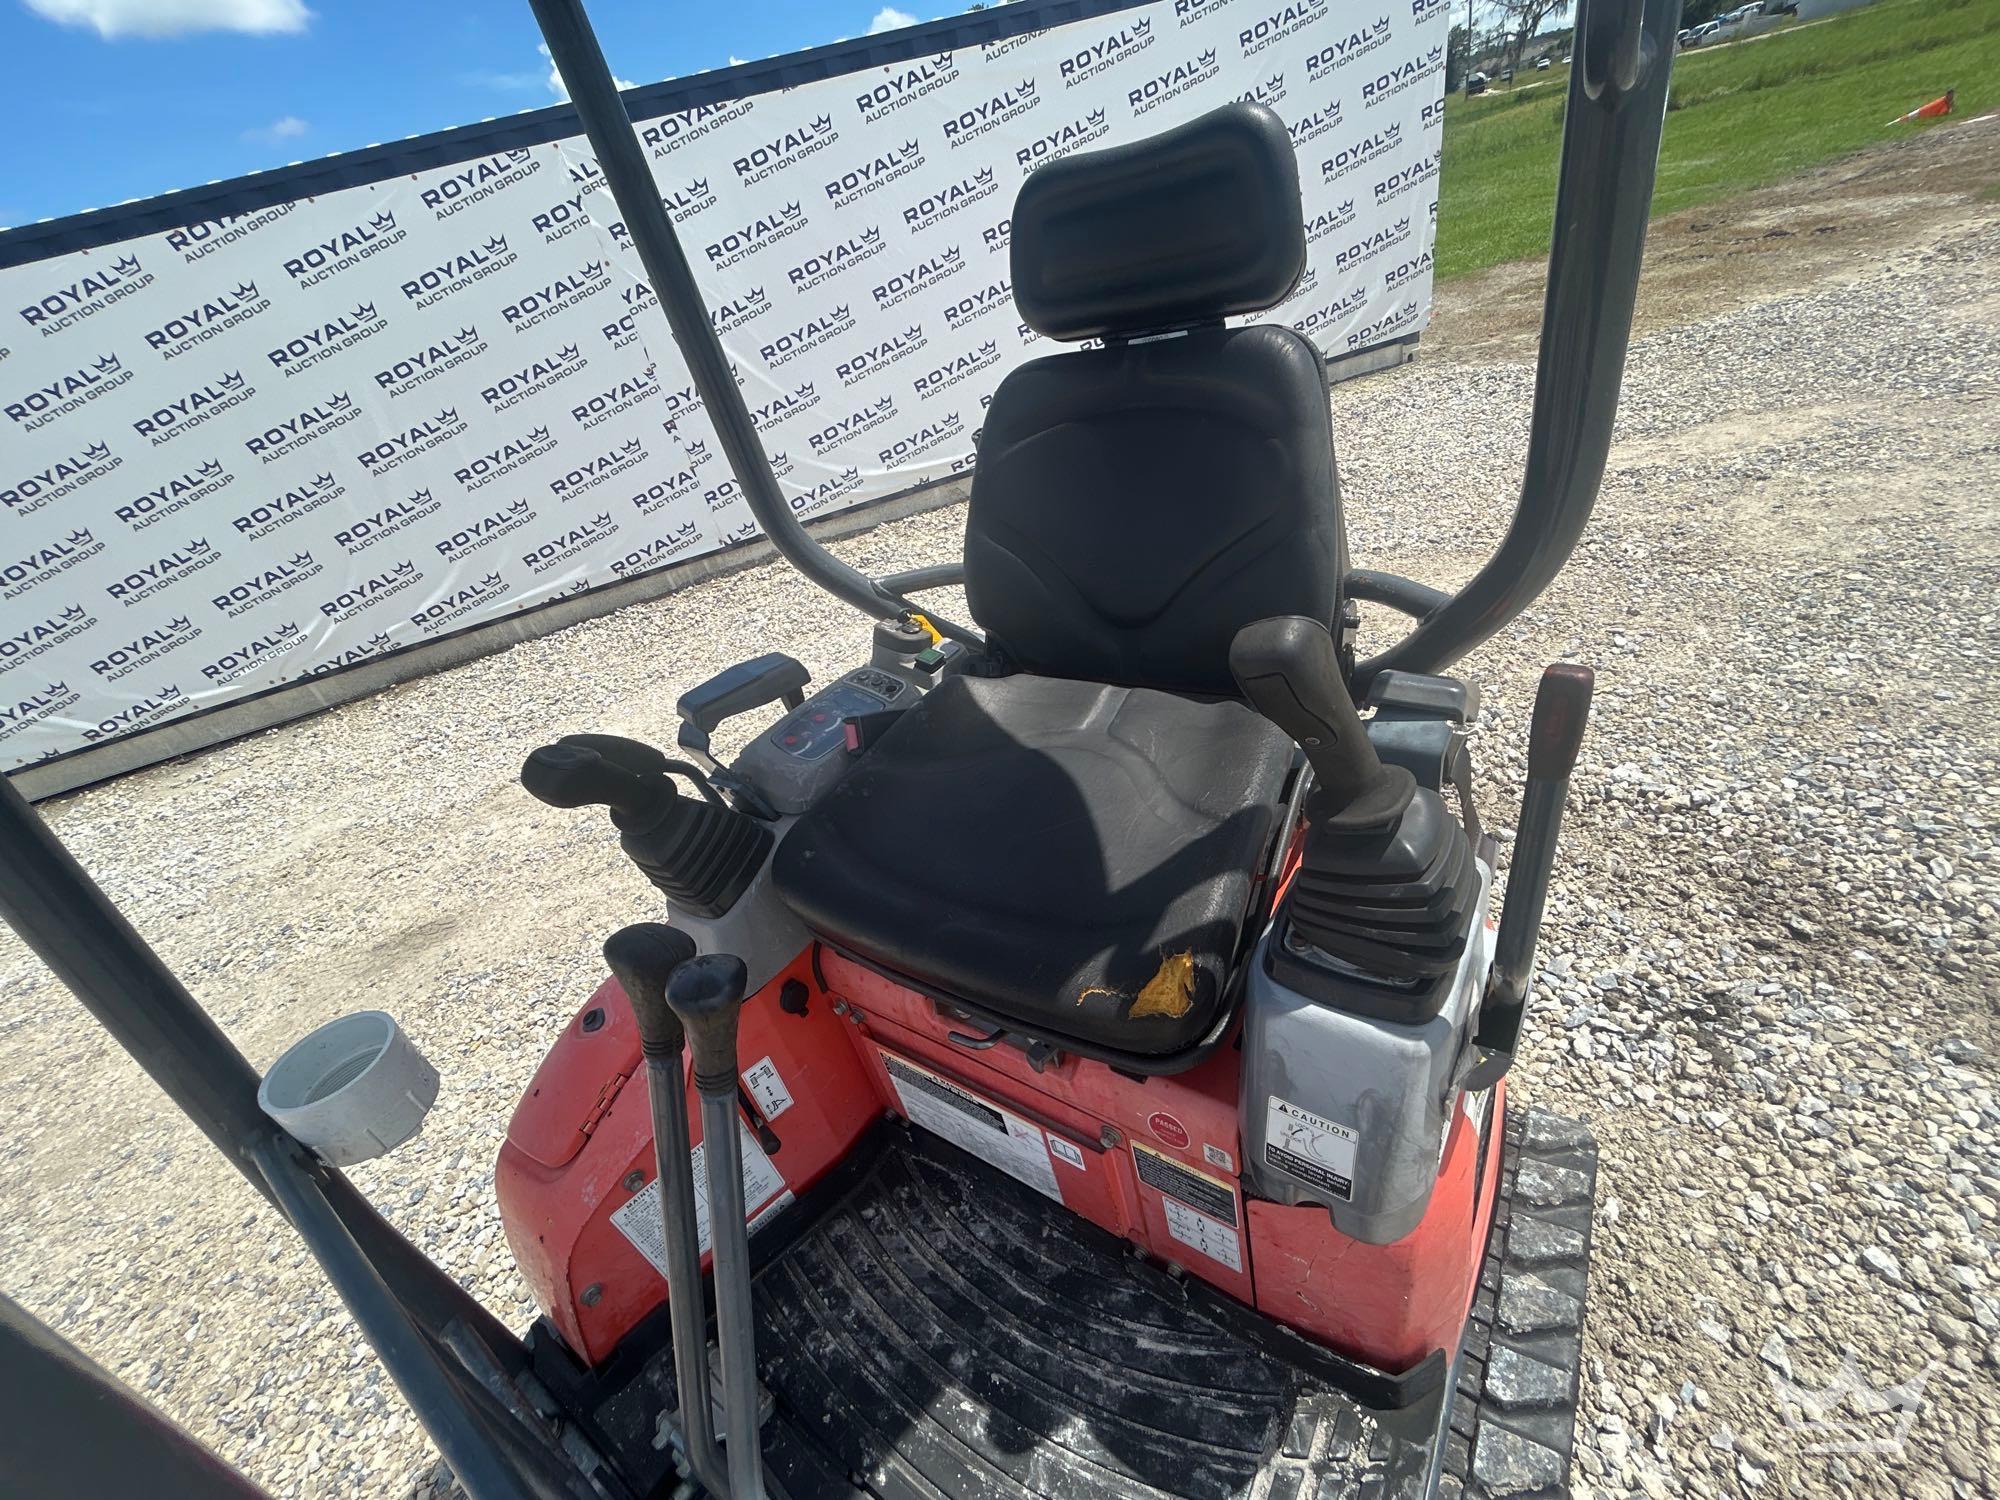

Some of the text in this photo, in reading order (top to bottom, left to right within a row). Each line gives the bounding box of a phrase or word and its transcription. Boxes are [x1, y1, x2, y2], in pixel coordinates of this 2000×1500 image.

[1240, 2, 1308, 48] ROYAL
[1244, 7, 1328, 58] AUCTION GROUP
[1060, 31, 1134, 78] ROYAL
[1066, 36, 1154, 89] AUCTION GROUP
[1306, 29, 1373, 72] ROYAL
[1310, 34, 1391, 83] AUCTION GROUP
[856, 65, 936, 113] ROYAL
[866, 70, 959, 124] AUCTION GROUP
[1128, 61, 1199, 106] ROYAL
[1134, 66, 1219, 117] AUCTION GROUP
[1362, 57, 1426, 99] ROYAL
[1366, 61, 1443, 109] AUCTION GROUP
[943, 92, 1018, 138] ROYAL
[952, 96, 1040, 149] AUCTION GROUP
[733, 128, 814, 176] ROYAL
[744, 132, 838, 188] AUCTION GROUP
[825, 153, 902, 199] ROYAL
[1322, 134, 1384, 175] ROYAL
[1325, 138, 1402, 184] AUCTION GROUP
[420, 157, 512, 209] ROYAL
[436, 162, 540, 221] AUCTION GROUP
[835, 156, 925, 210] AUCTION GROUP
[903, 180, 976, 224] ROYAL
[912, 183, 998, 234] AUCTION GROUP
[283, 226, 377, 278] ROYAL
[300, 230, 406, 290] AUCTION GROUP
[705, 215, 784, 262] ROYAL
[716, 218, 808, 272] AUCTION GROUP
[788, 240, 863, 284] ROYAL
[1336, 228, 1394, 266] ROYAL
[1338, 230, 1410, 274] AUCTION GROUP
[401, 250, 490, 300] ROYAL
[416, 253, 517, 310] AUCTION GROUP
[798, 242, 886, 294] AUCTION GROUP
[872, 258, 944, 302] ROYAL
[881, 261, 965, 311] AUCTION GROUP
[20, 271, 121, 326] ROYAL
[41, 274, 154, 337] AUCTION GROUP
[501, 276, 585, 323] ROYAL
[515, 278, 611, 334] AUCTION GROUP
[144, 297, 240, 350] ROYAL
[163, 300, 270, 360] AUCTION GROUP
[268, 318, 358, 367] ROYAL
[760, 317, 834, 360] ROYAL
[770, 319, 856, 370] AUCTION GROUP
[285, 320, 388, 378] AUCTION GROUP
[374, 341, 461, 389] ROYAL
[390, 343, 488, 398] AUCTION GROUP
[836, 337, 906, 379] ROYAL
[845, 339, 927, 388] AUCTION GROUP
[914, 352, 981, 392] ROYAL
[4, 370, 102, 422] ROYAL
[24, 371, 134, 432] AUCTION GROUP
[481, 358, 562, 404] ROYAL
[494, 359, 588, 414] AUCTION GROUP
[922, 354, 1001, 400] AUCTION GROUP
[133, 387, 226, 437] ROYAL
[152, 388, 256, 446] AUCTION GROUP
[245, 407, 334, 455] ROYAL
[262, 408, 362, 464] AUCTION GROUP
[808, 408, 877, 448] ROYAL
[818, 409, 898, 456] AUCTION GROUP
[357, 422, 441, 468] ROYAL
[372, 423, 468, 477] AUCTION GROUP
[454, 440, 533, 484] ROYAL
[467, 440, 558, 492] AUCTION GROUP
[879, 424, 944, 463] ROYAL
[887, 425, 964, 470] AUCTION GROUP
[550, 452, 625, 494] ROYAL
[562, 452, 648, 502] AUCTION GROUP
[114, 474, 205, 523] ROYAL
[133, 474, 234, 532] AUCTION GROUP
[232, 487, 318, 533] ROYAL
[249, 487, 345, 542] AUCTION GROUP
[334, 502, 415, 547] ROYAL
[349, 502, 441, 555] AUCTION GROUP
[435, 512, 512, 556] ROYAL
[448, 512, 536, 563] AUCTION GROUP
[522, 526, 596, 567] ROYAL
[534, 525, 619, 574] AUCTION GROUP
[106, 553, 193, 599] ROYAL
[124, 552, 221, 607] AUCTION GROUP
[212, 566, 296, 610] ROYAL
[228, 564, 323, 618] AUCTION GROUP
[320, 574, 398, 617] ROYAL
[334, 573, 423, 624] AUCTION GROUP
[410, 585, 486, 626] ROYAL
[424, 584, 510, 633] AUCTION GROUP
[90, 630, 175, 675] ROYAL
[107, 628, 202, 682] AUCTION GROUP
[1291, 1109, 1350, 1138] CAUTION
[1294, 1158, 1326, 1175] PERSONAL
